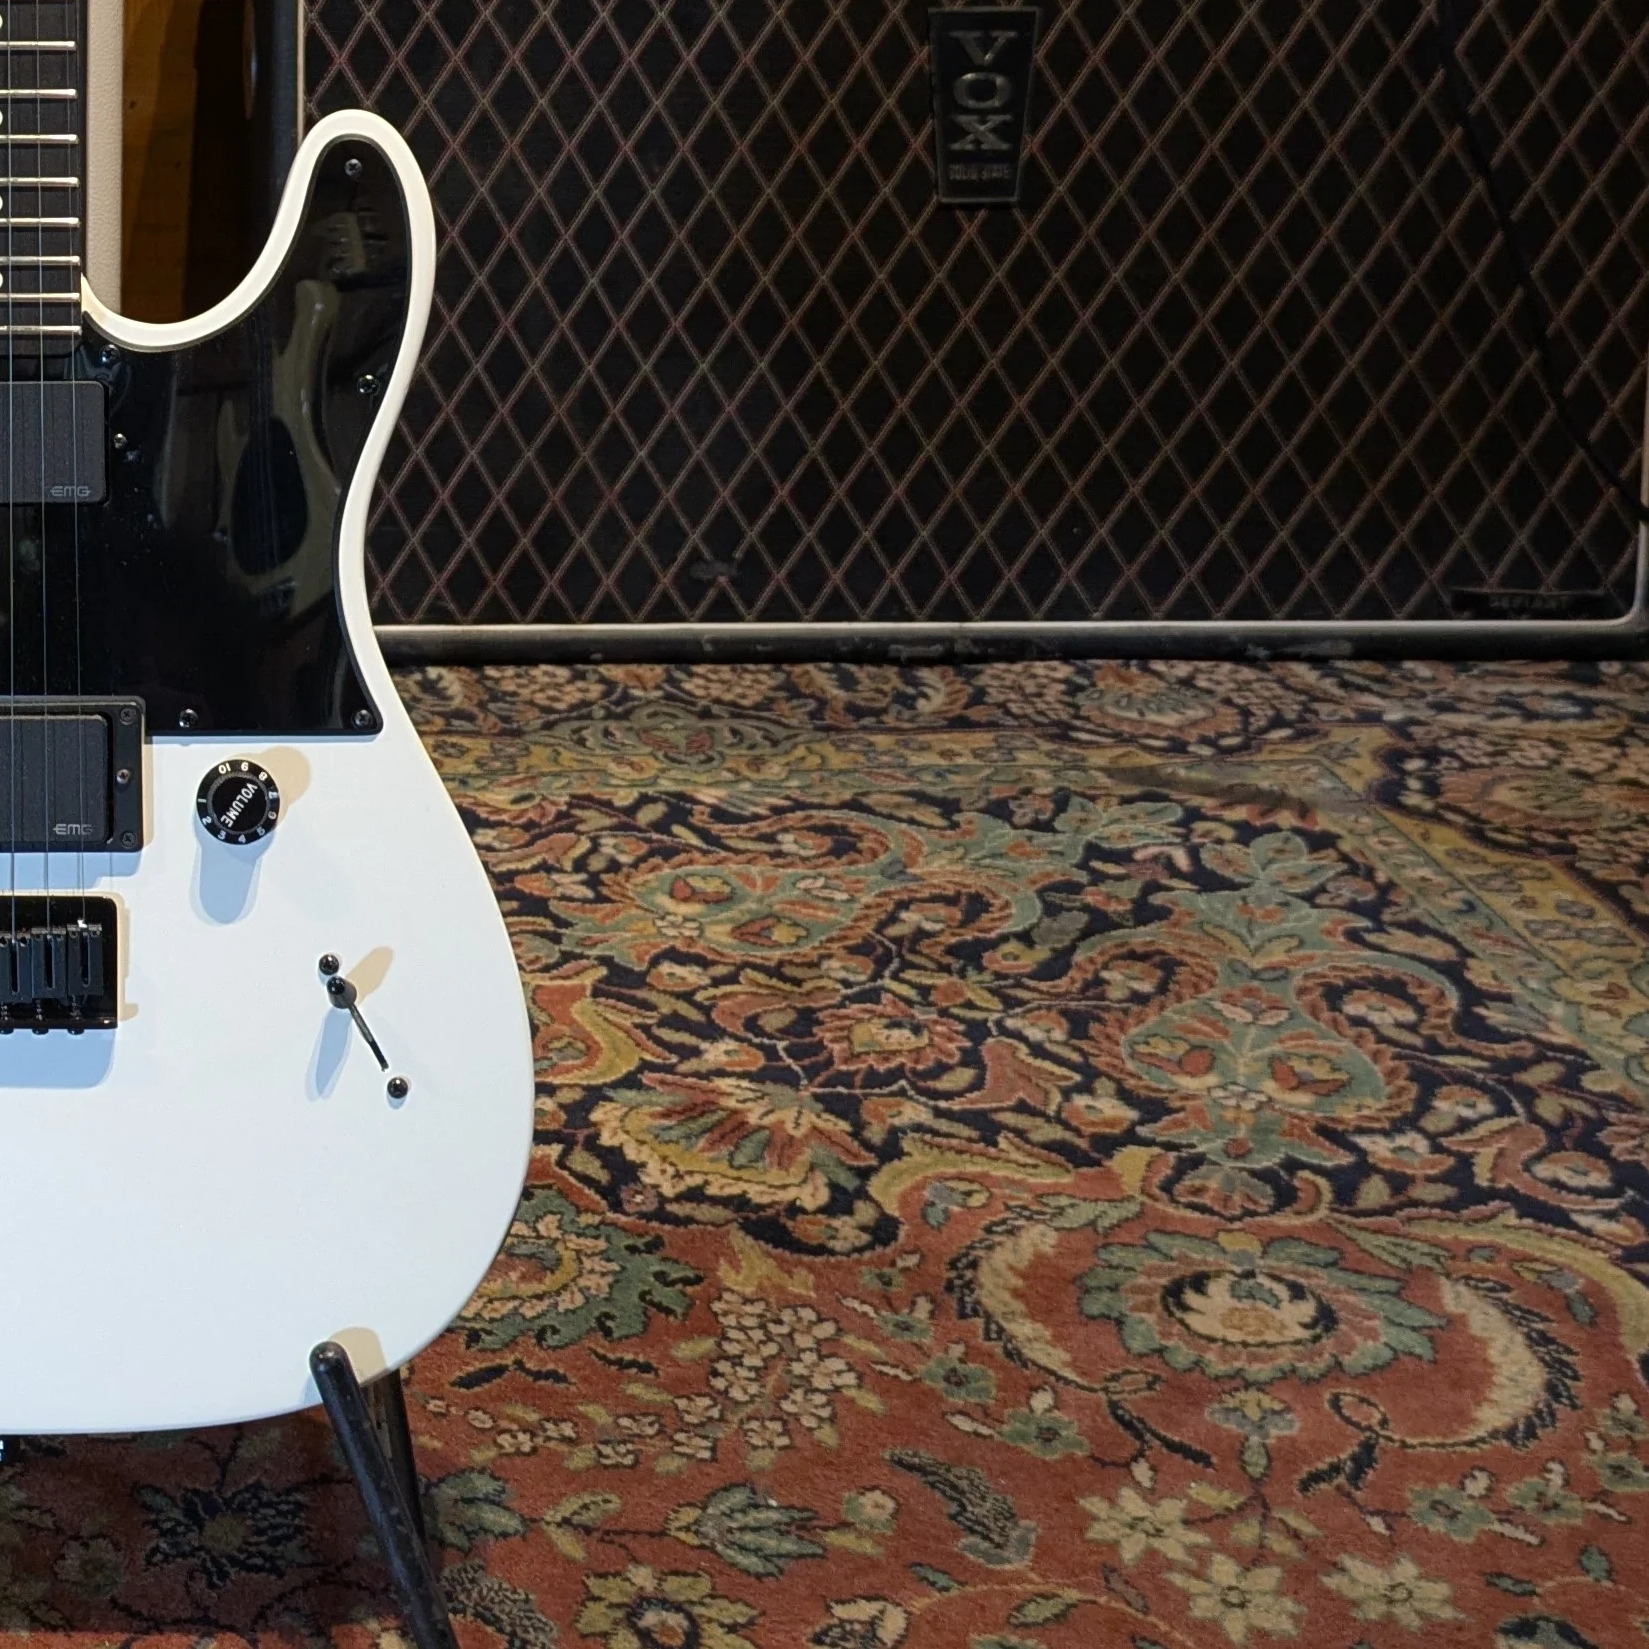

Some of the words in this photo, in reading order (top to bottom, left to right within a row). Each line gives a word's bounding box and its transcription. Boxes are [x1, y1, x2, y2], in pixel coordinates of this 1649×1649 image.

[949, 30, 1019, 151] VOX
[50, 485, 92, 497] EMG
[220, 783, 258, 828] VOLUME
[53, 823, 94, 836] EMG
